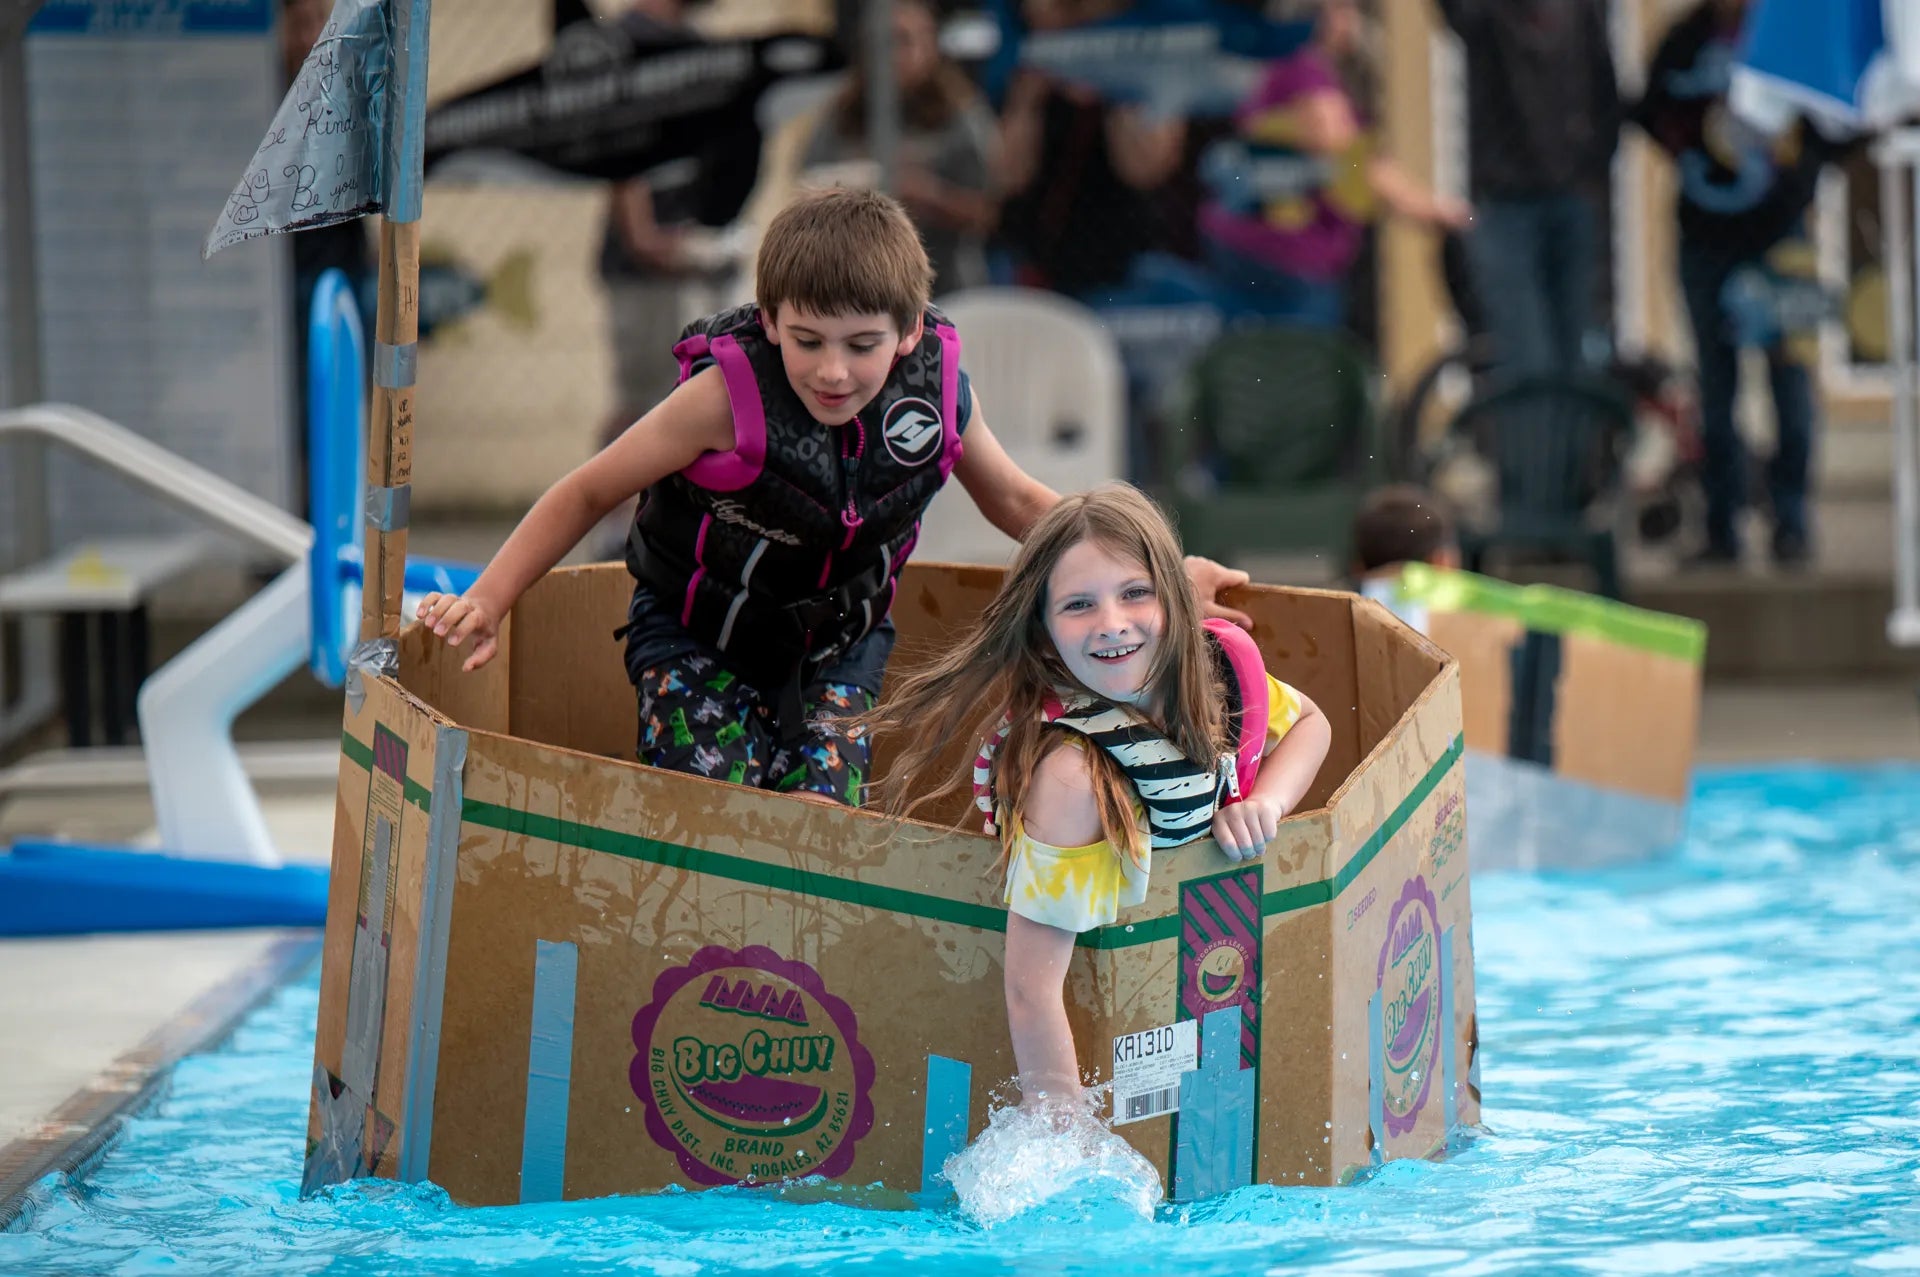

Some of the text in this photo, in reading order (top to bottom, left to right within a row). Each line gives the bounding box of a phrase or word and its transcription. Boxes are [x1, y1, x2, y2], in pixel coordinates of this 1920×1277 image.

[283, 164, 359, 212] Be you
[1353, 886, 1377, 922] SEEDED
[1194, 939, 1250, 967] LYCOPENE LEADER
[651, 1047, 665, 1073] BIG
[673, 1028, 835, 1084] BIG CHUY
[1113, 1026, 1174, 1063] KA131D
[653, 1080, 677, 1116] CHUY
[828, 1091, 849, 1133] 85621
[724, 1137, 784, 1157] BRAND
[815, 1132, 833, 1154] AZ
[709, 1151, 738, 1174] INC.
